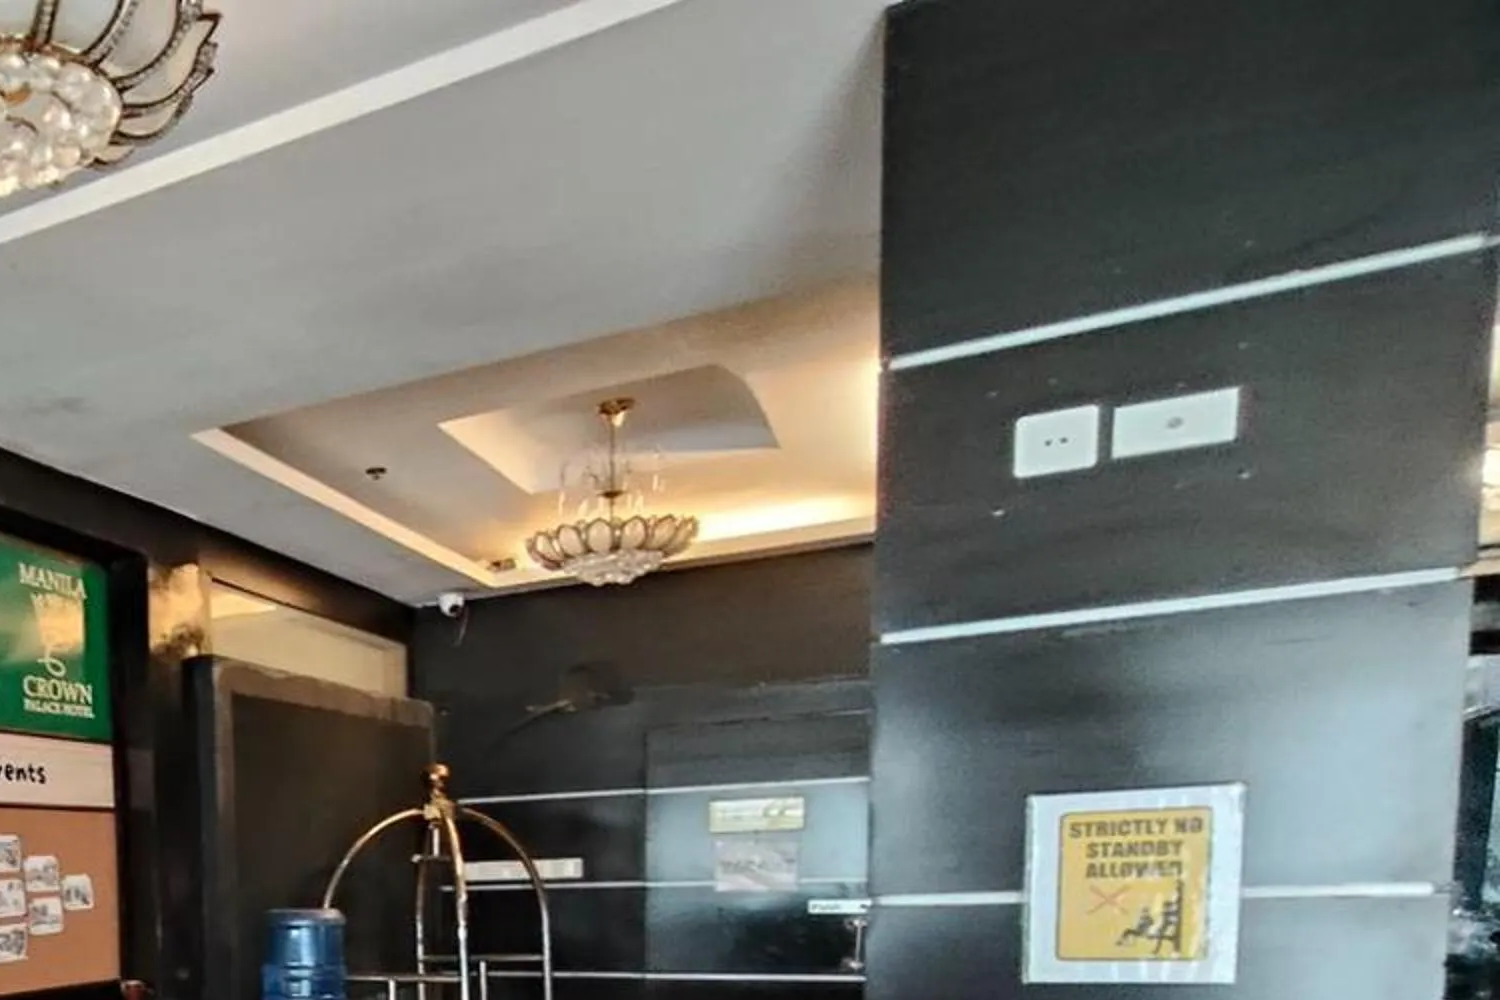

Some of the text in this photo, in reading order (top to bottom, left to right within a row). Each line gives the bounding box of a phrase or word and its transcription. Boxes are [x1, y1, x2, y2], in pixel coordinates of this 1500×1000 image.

[18, 562, 88, 600] MANILA
[23, 675, 93, 705] CROWN
[1068, 815, 1204, 839] STRICTLY NO
[1085, 840, 1183, 859] STANDBY
